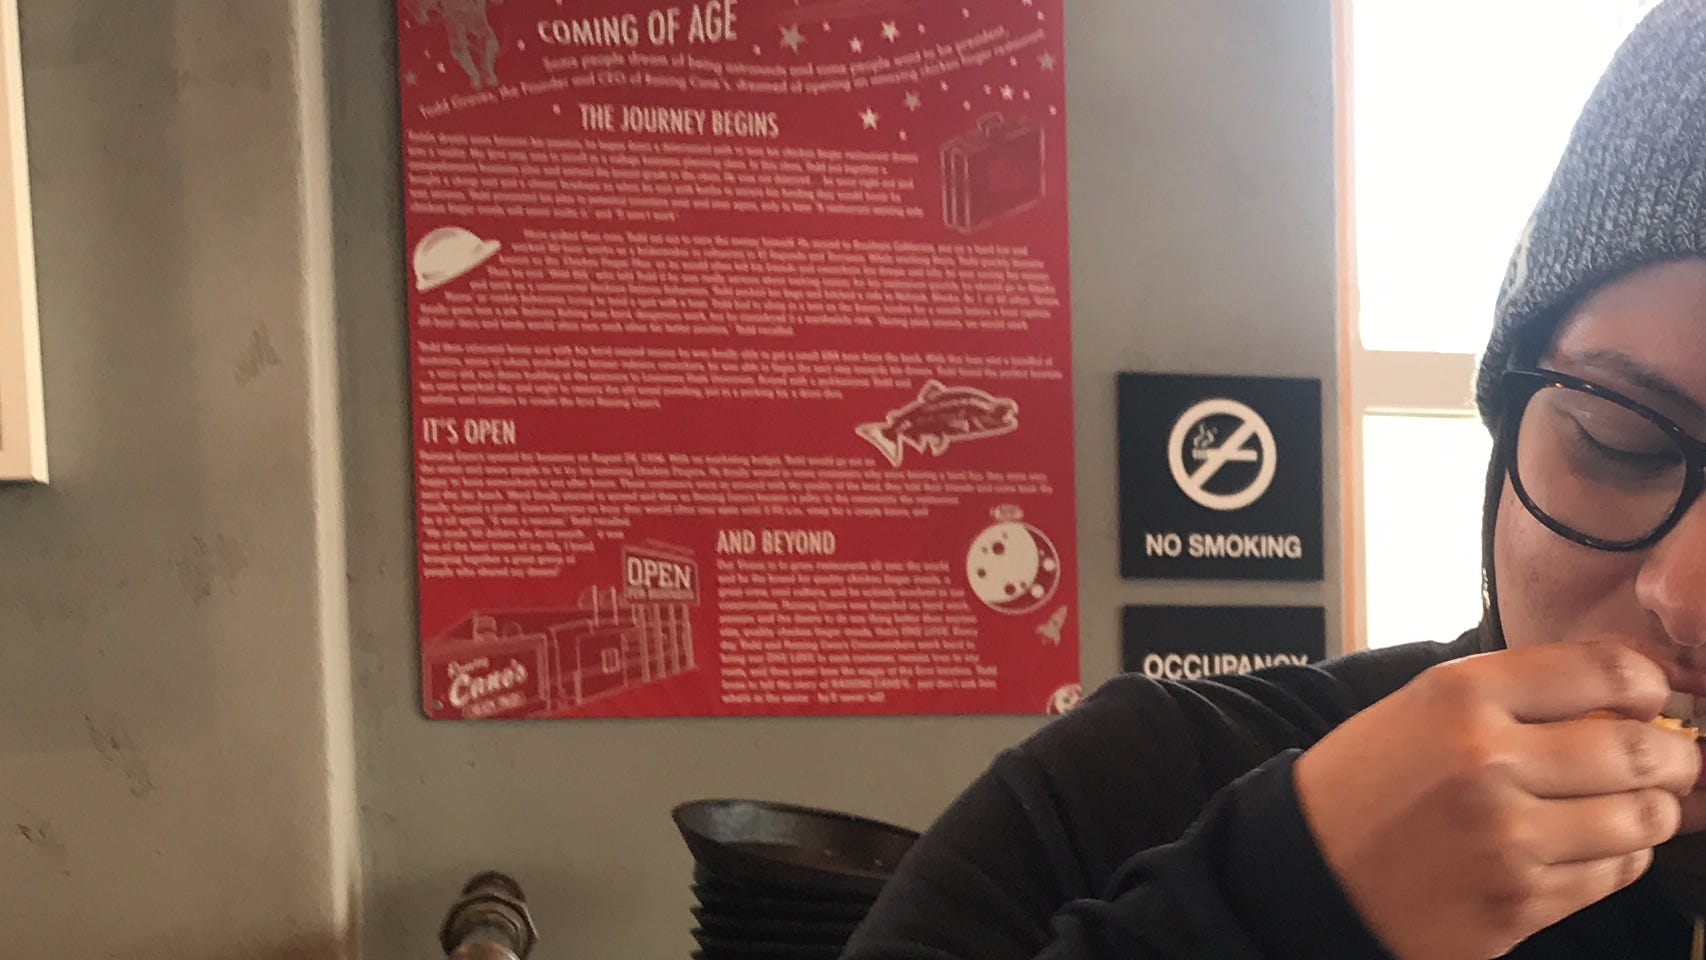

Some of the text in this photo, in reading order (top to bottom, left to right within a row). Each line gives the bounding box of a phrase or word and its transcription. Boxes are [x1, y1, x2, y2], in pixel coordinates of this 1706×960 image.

[537, 0, 738, 46] COMING OF AGE
[579, 103, 780, 139] THE JOURNEY BEGINS
[422, 417, 517, 445] IT'S OPEN
[717, 529, 837, 554] AND BEYOND
[1145, 532, 1303, 559] NO SMOKING
[626, 555, 693, 590] OPEN
